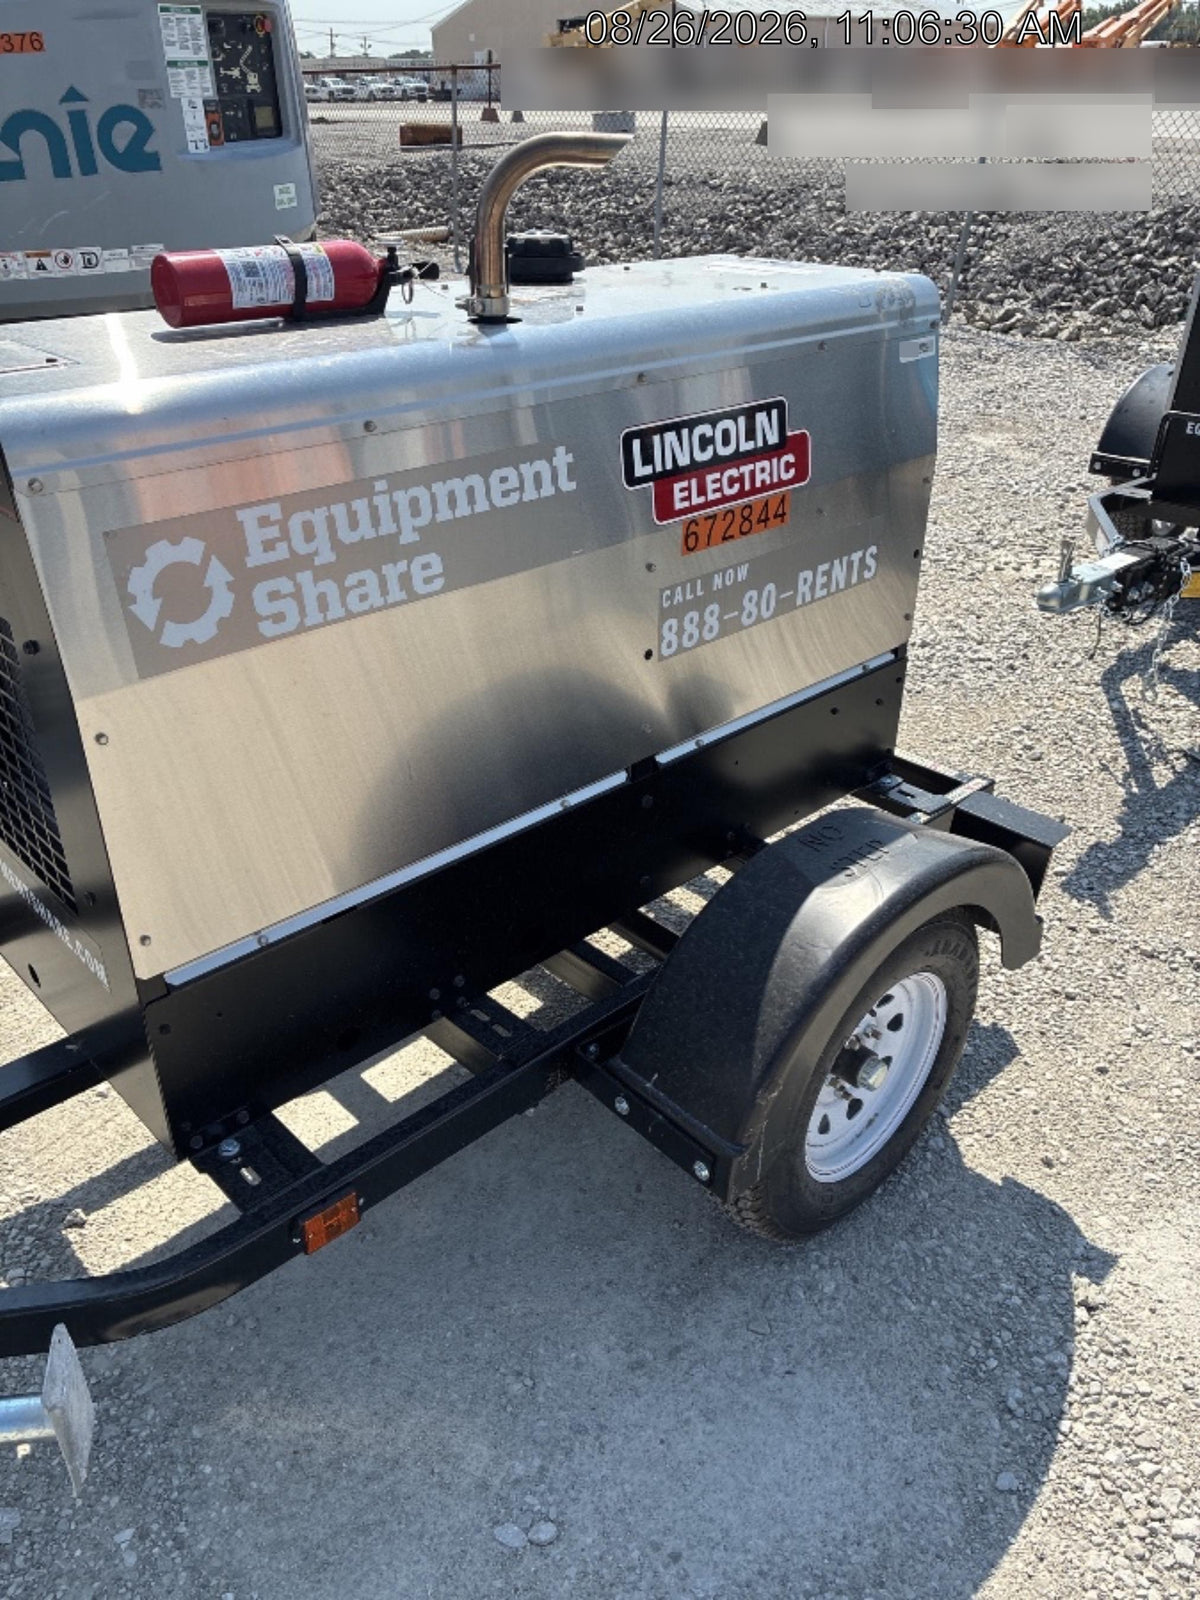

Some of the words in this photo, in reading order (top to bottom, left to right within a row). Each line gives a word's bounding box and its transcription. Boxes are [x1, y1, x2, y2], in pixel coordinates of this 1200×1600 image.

[632, 408, 780, 478] LINCOLN
[236, 445, 578, 568] Equipment
[673, 453, 796, 511] ELECTRIC
[684, 495, 788, 553] 672844
[251, 551, 446, 639] Share
[660, 544, 879, 657] 888-80-RENTS
[662, 581, 705, 608] CALL
[713, 563, 749, 591] NOW
[798, 824, 845, 853] NO
